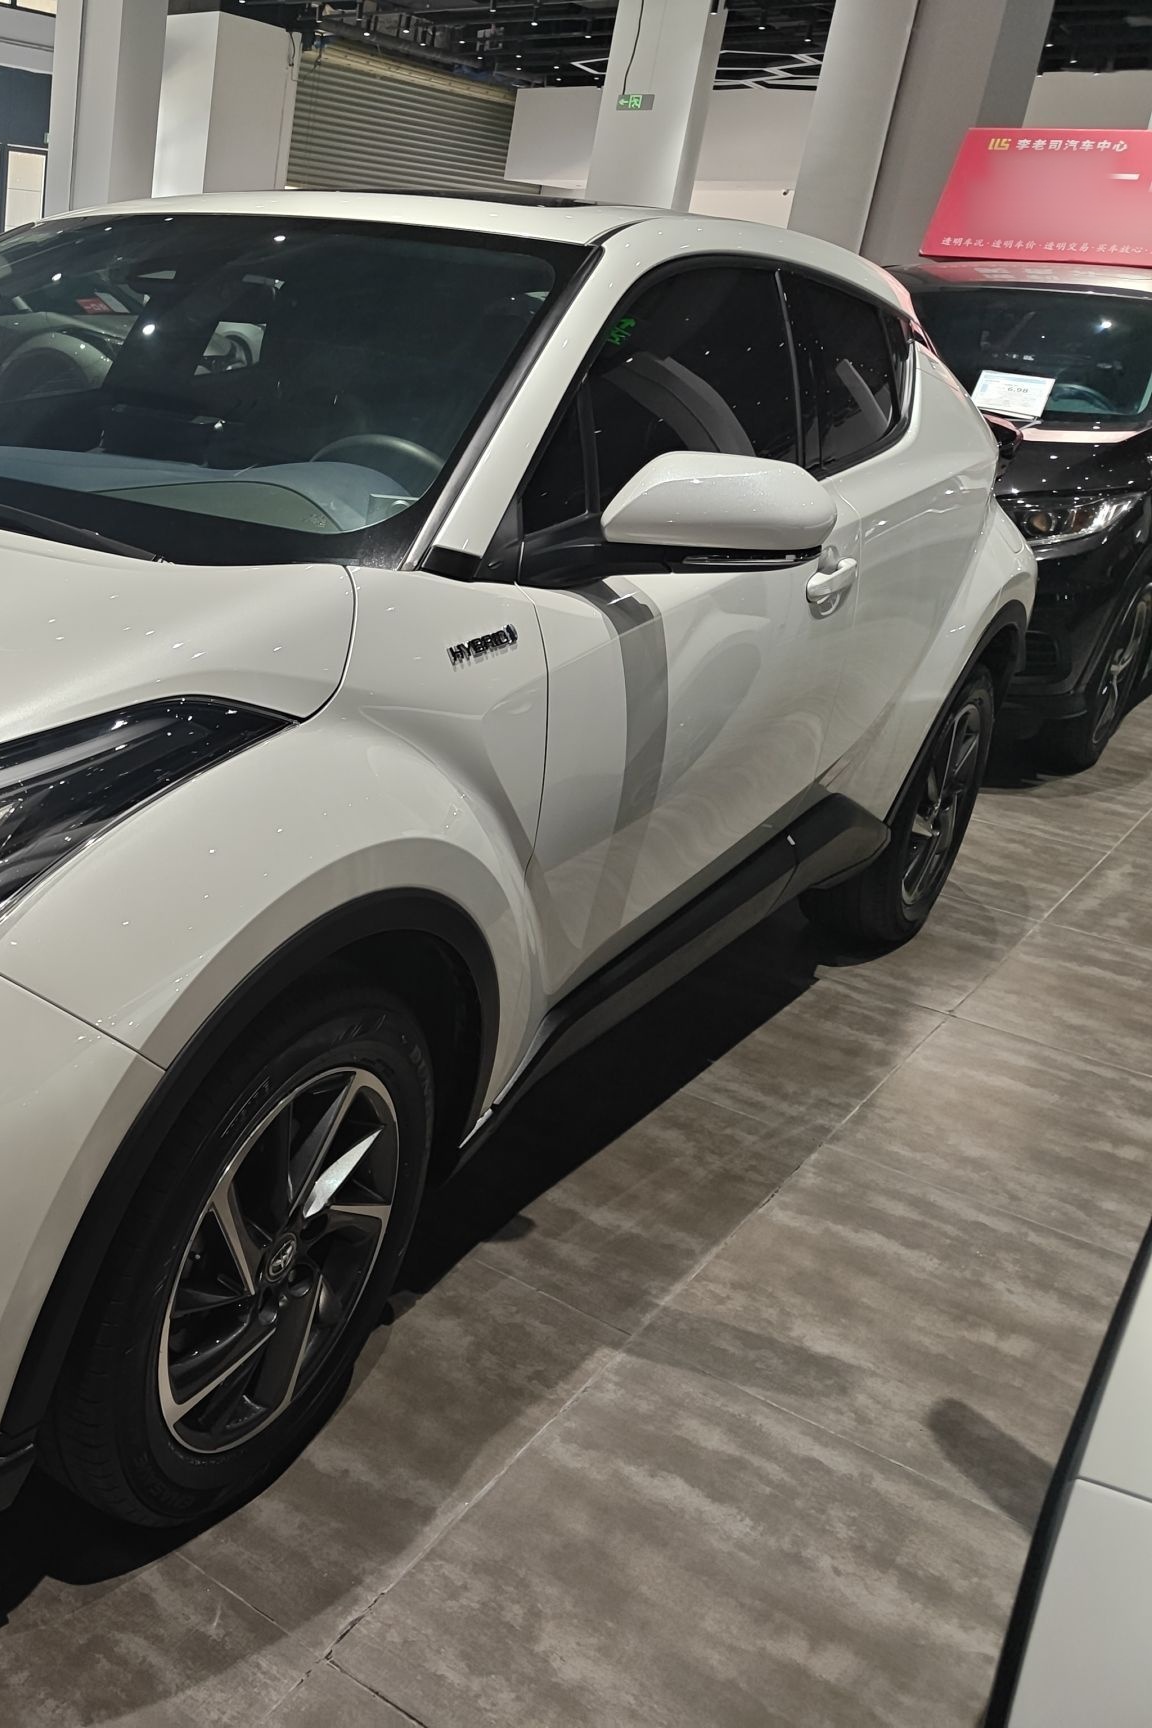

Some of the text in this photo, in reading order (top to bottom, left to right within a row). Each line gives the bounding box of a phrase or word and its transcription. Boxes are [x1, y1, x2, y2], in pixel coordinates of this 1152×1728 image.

[1016, 139, 1128, 152] 李老司汽车中心
[447, 624, 518, 665] HYBRID
